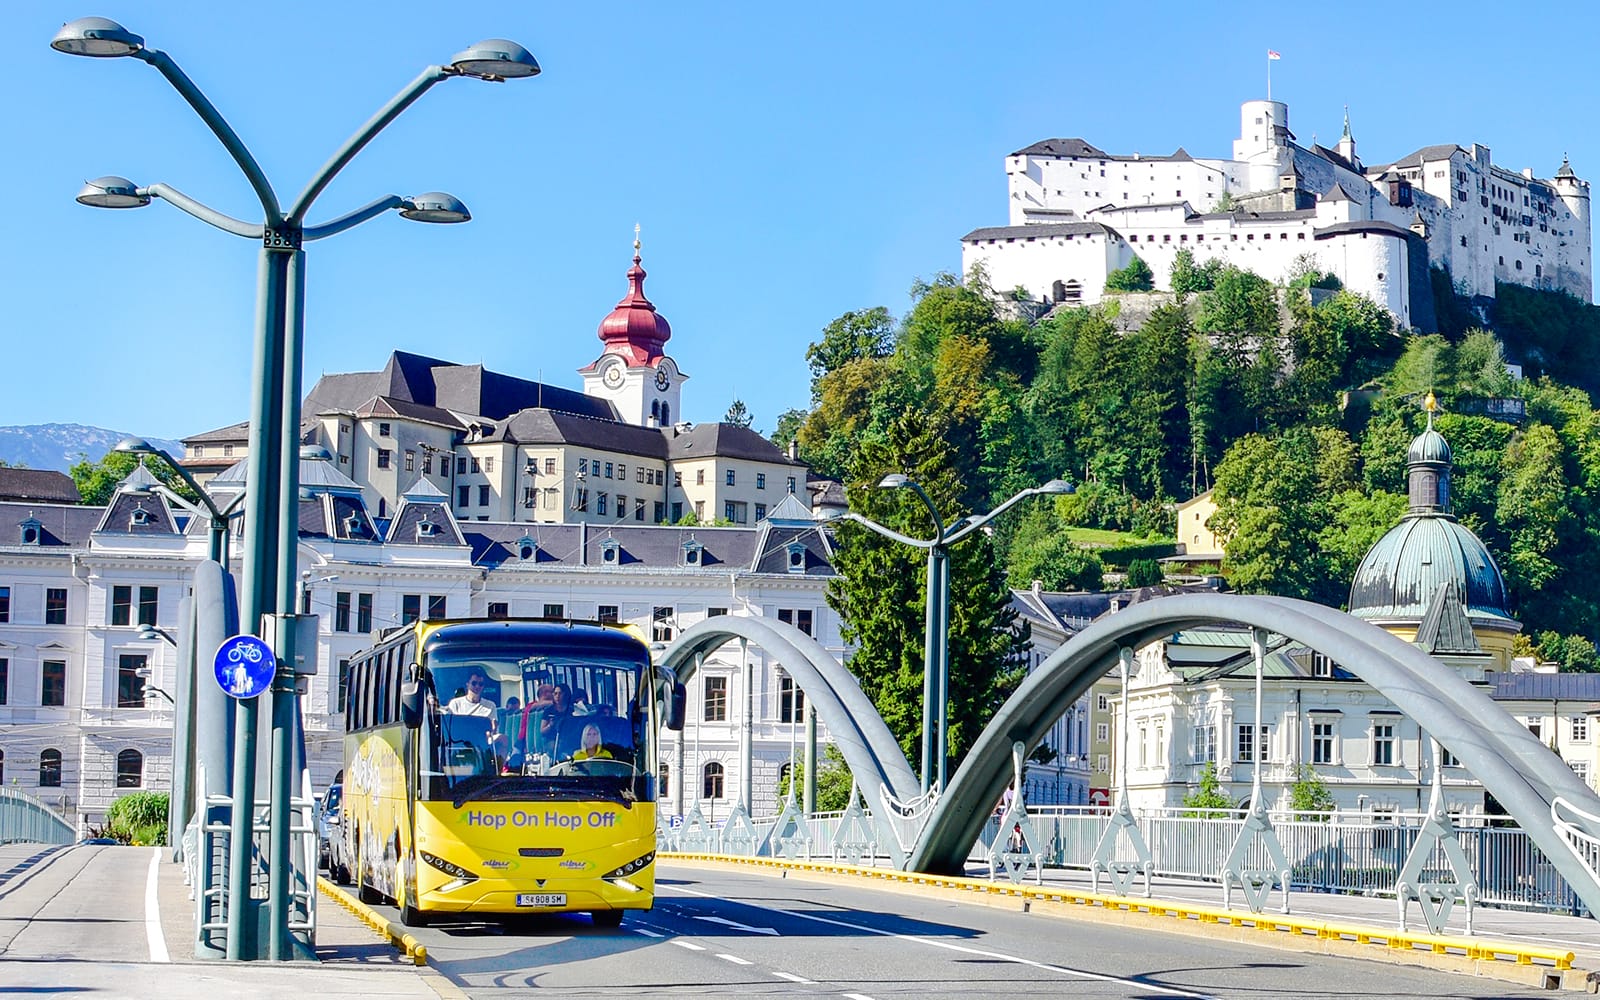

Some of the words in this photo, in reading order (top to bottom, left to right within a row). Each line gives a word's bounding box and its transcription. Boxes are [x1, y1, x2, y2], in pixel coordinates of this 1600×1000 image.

[468, 810, 506, 830] Hop
[512, 810, 538, 827] On
[545, 811, 582, 831] Hop
[588, 811, 615, 827] Off
